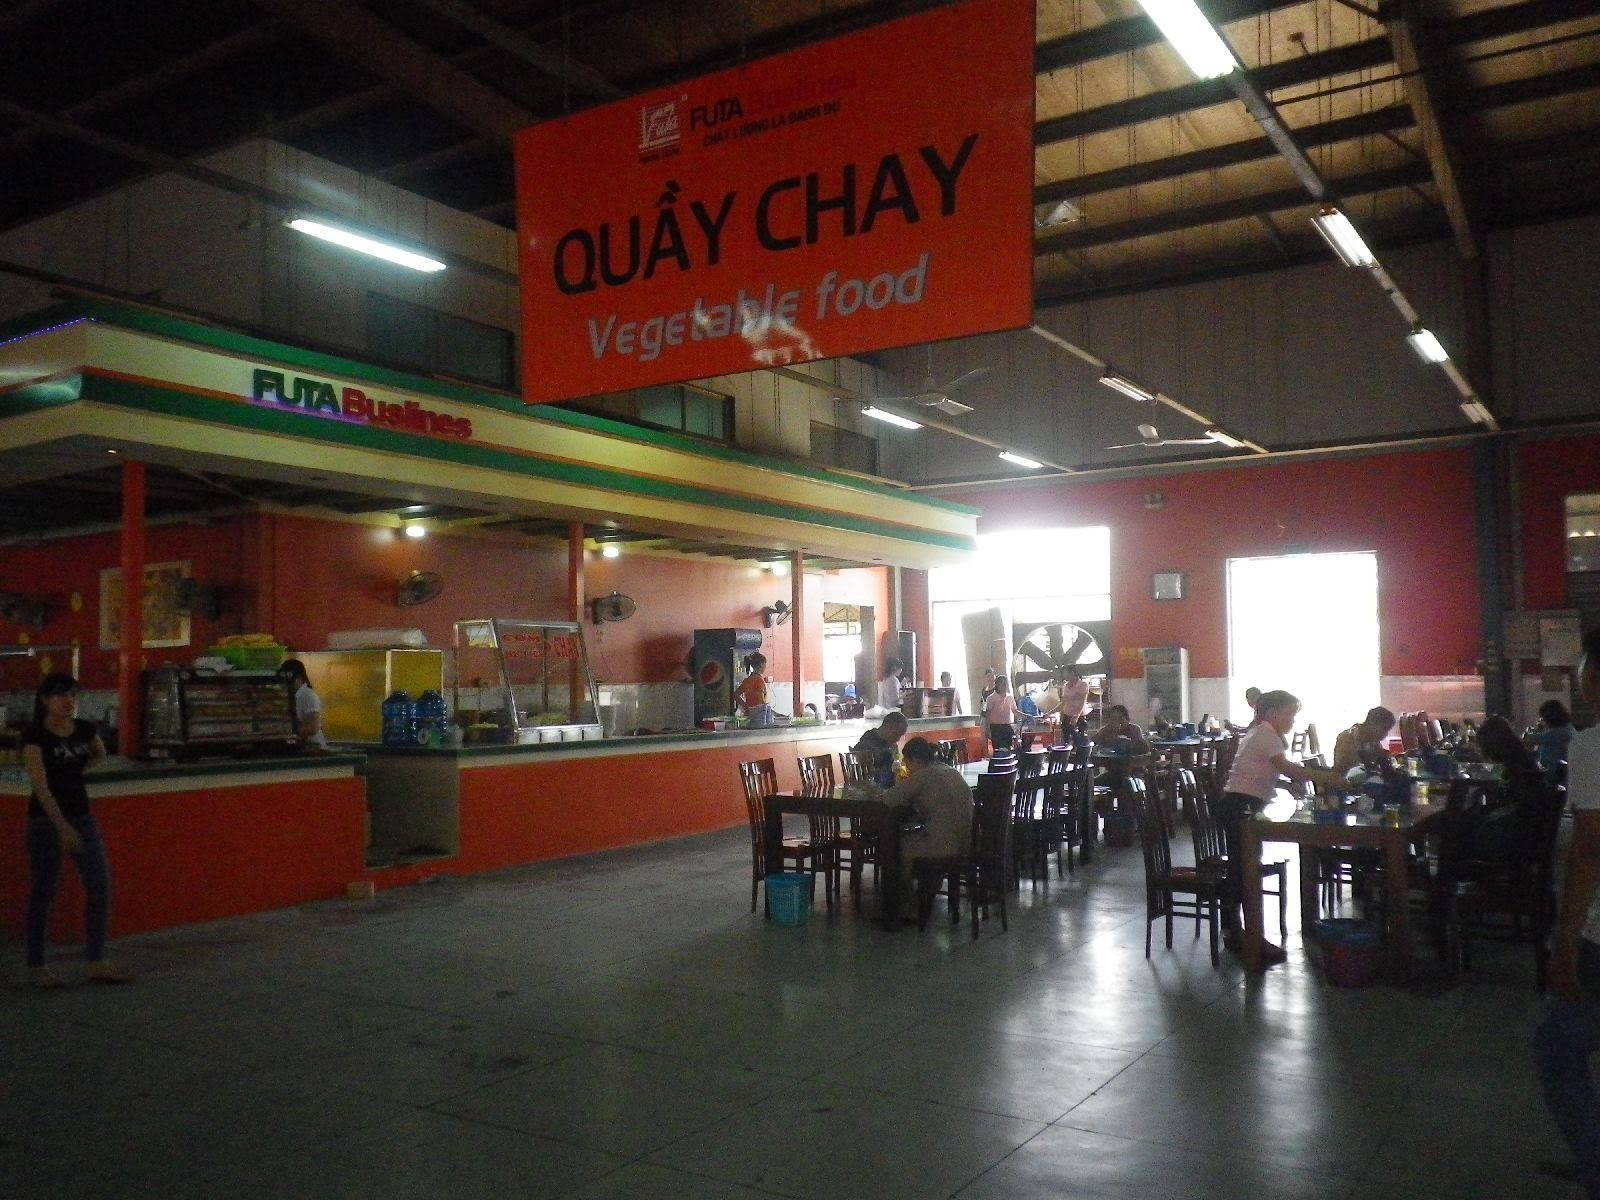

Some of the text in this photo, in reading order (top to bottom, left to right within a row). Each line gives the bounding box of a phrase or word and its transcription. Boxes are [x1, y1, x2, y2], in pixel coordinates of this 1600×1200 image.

[690, 97, 743, 131] FUTA
[554, 133, 980, 295] QUẦY CHAY
[588, 252, 931, 362] Vegetable food
